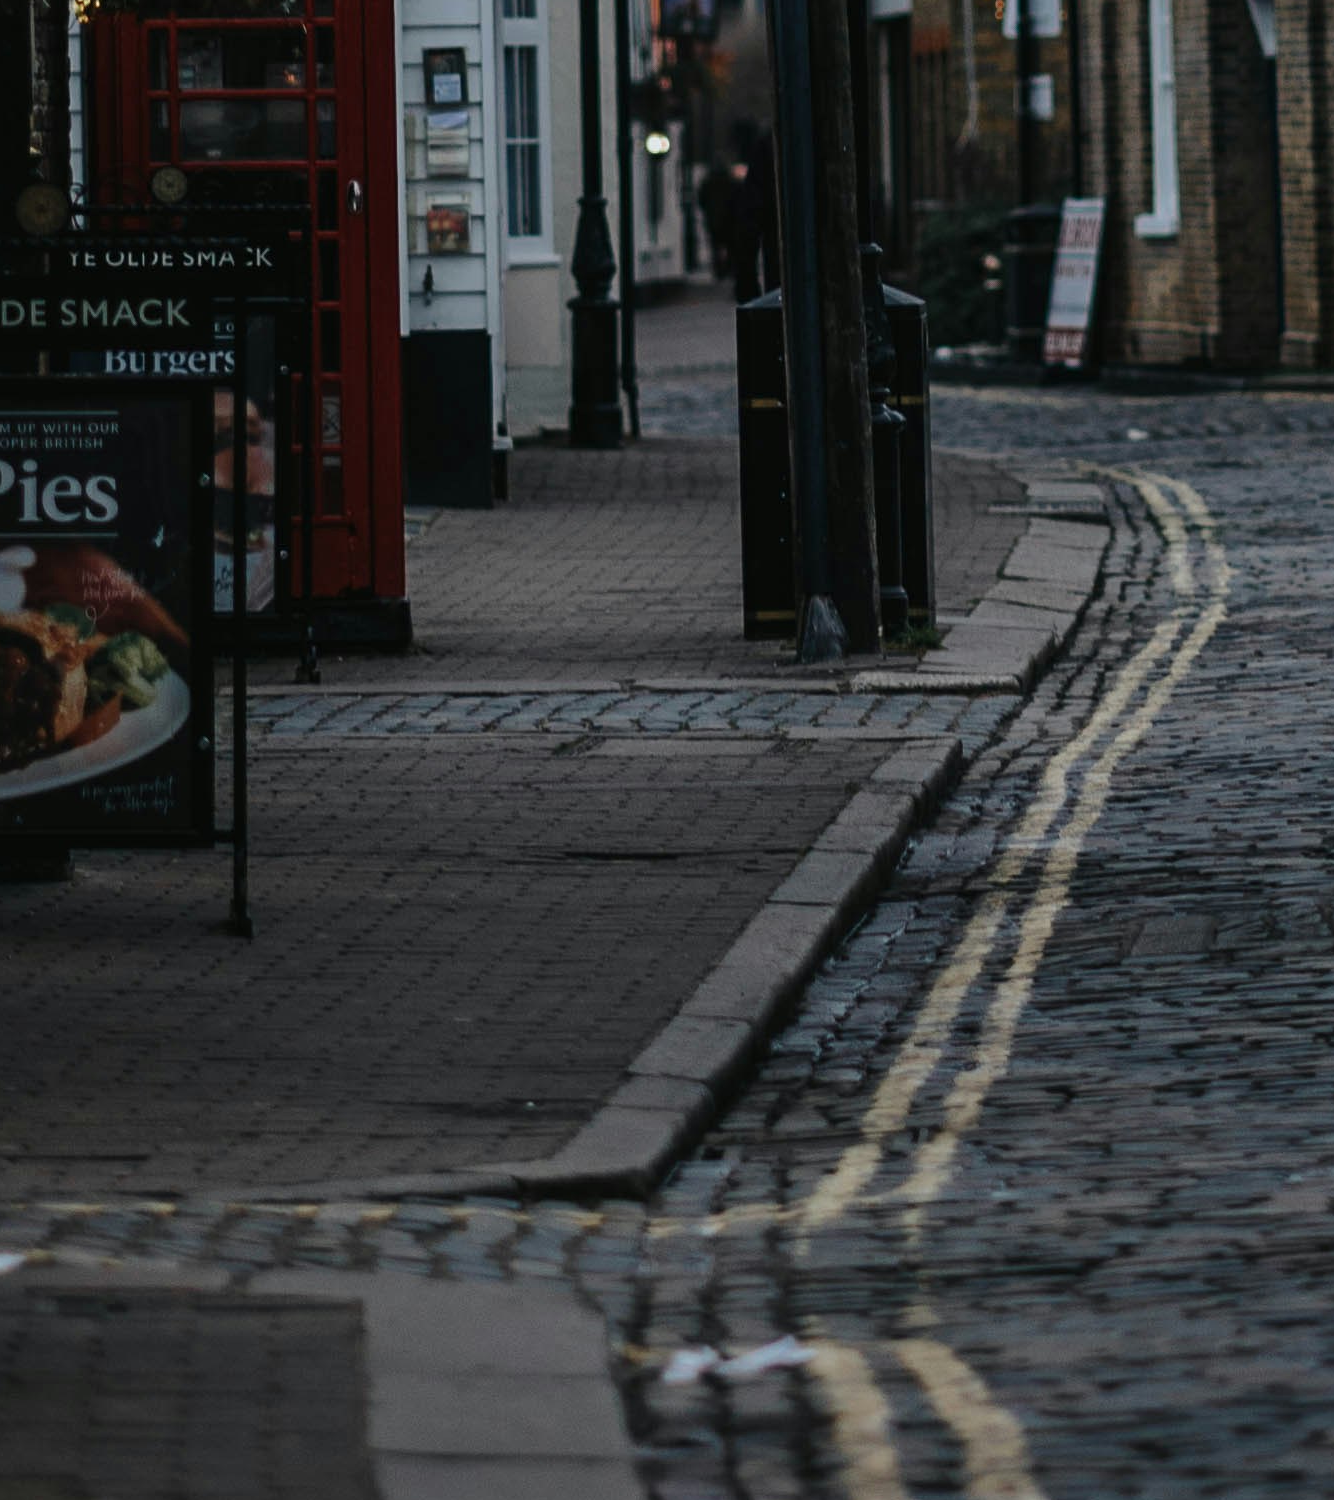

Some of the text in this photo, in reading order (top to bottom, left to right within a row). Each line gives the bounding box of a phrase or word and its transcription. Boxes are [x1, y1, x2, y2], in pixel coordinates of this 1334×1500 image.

[69, 250, 97, 267] YE
[105, 250, 174, 267] OLDE
[60, 297, 191, 327] SMACK
[105, 348, 235, 375] Burgers
[17, 422, 37, 434] UP
[42, 422, 83, 434] WITH
[87, 422, 121, 434] OUR
[44, 436, 104, 449] BRITISH
